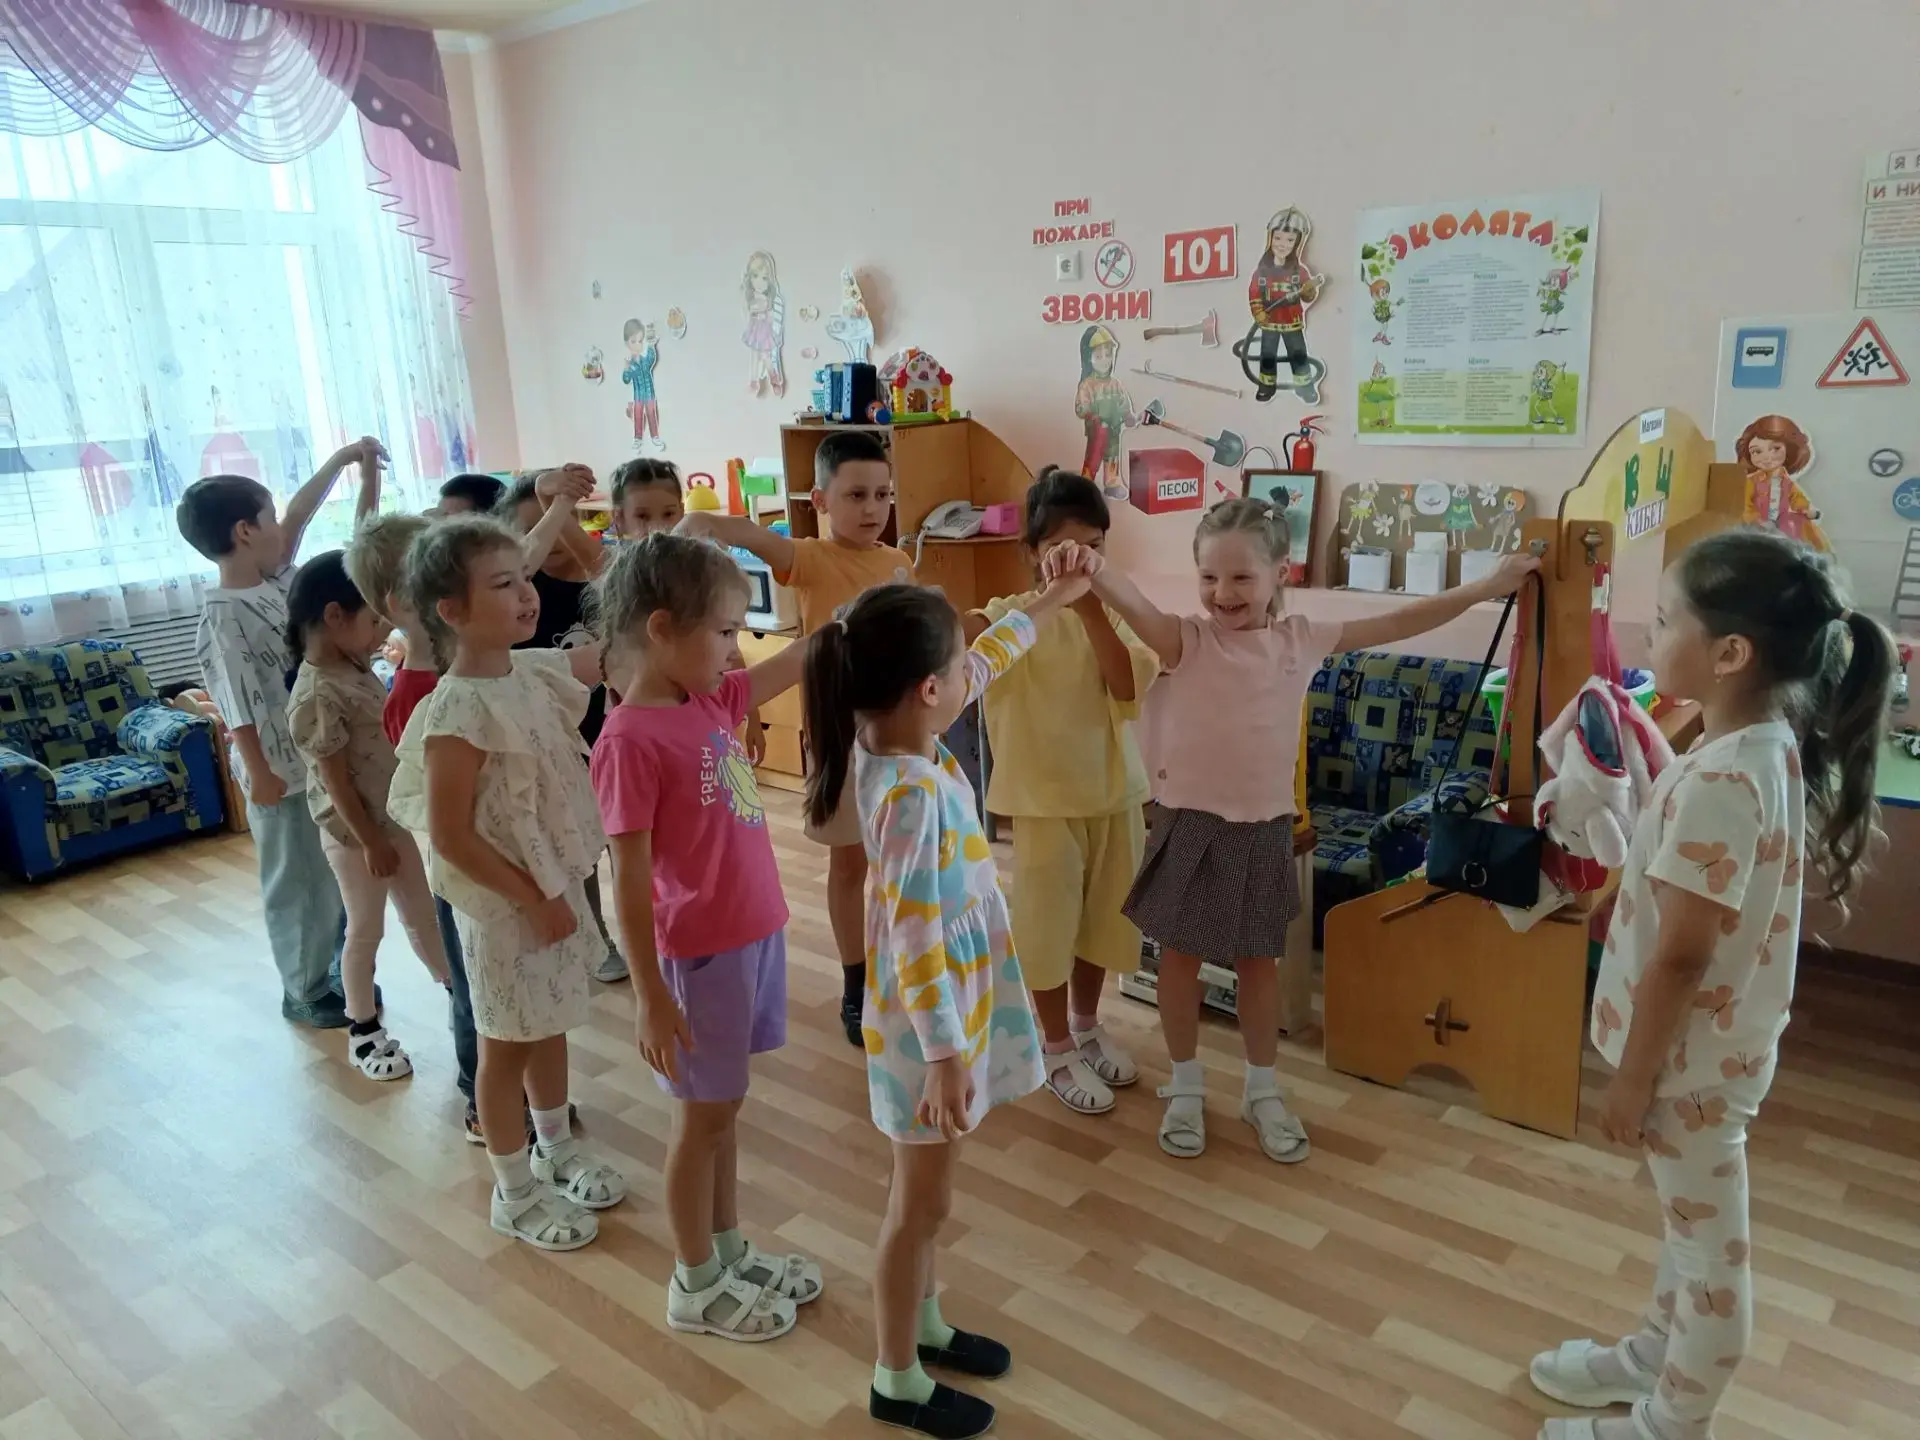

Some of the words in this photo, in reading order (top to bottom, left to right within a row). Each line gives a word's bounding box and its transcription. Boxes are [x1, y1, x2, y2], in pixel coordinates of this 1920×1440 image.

[1054, 198, 1089, 217] ПРИ
[1032, 221, 1112, 245] ПОЖАРЕ
[1388, 208, 1554, 260] ЭКОЛЯТА
[1169, 234, 1229, 276] 101
[1041, 289, 1150, 323] ЗВОНИ
[1158, 480, 1197, 497] ПЕСОК
[1626, 498, 1665, 538] КИБЕТ
[701, 746, 716, 806] FRESH
